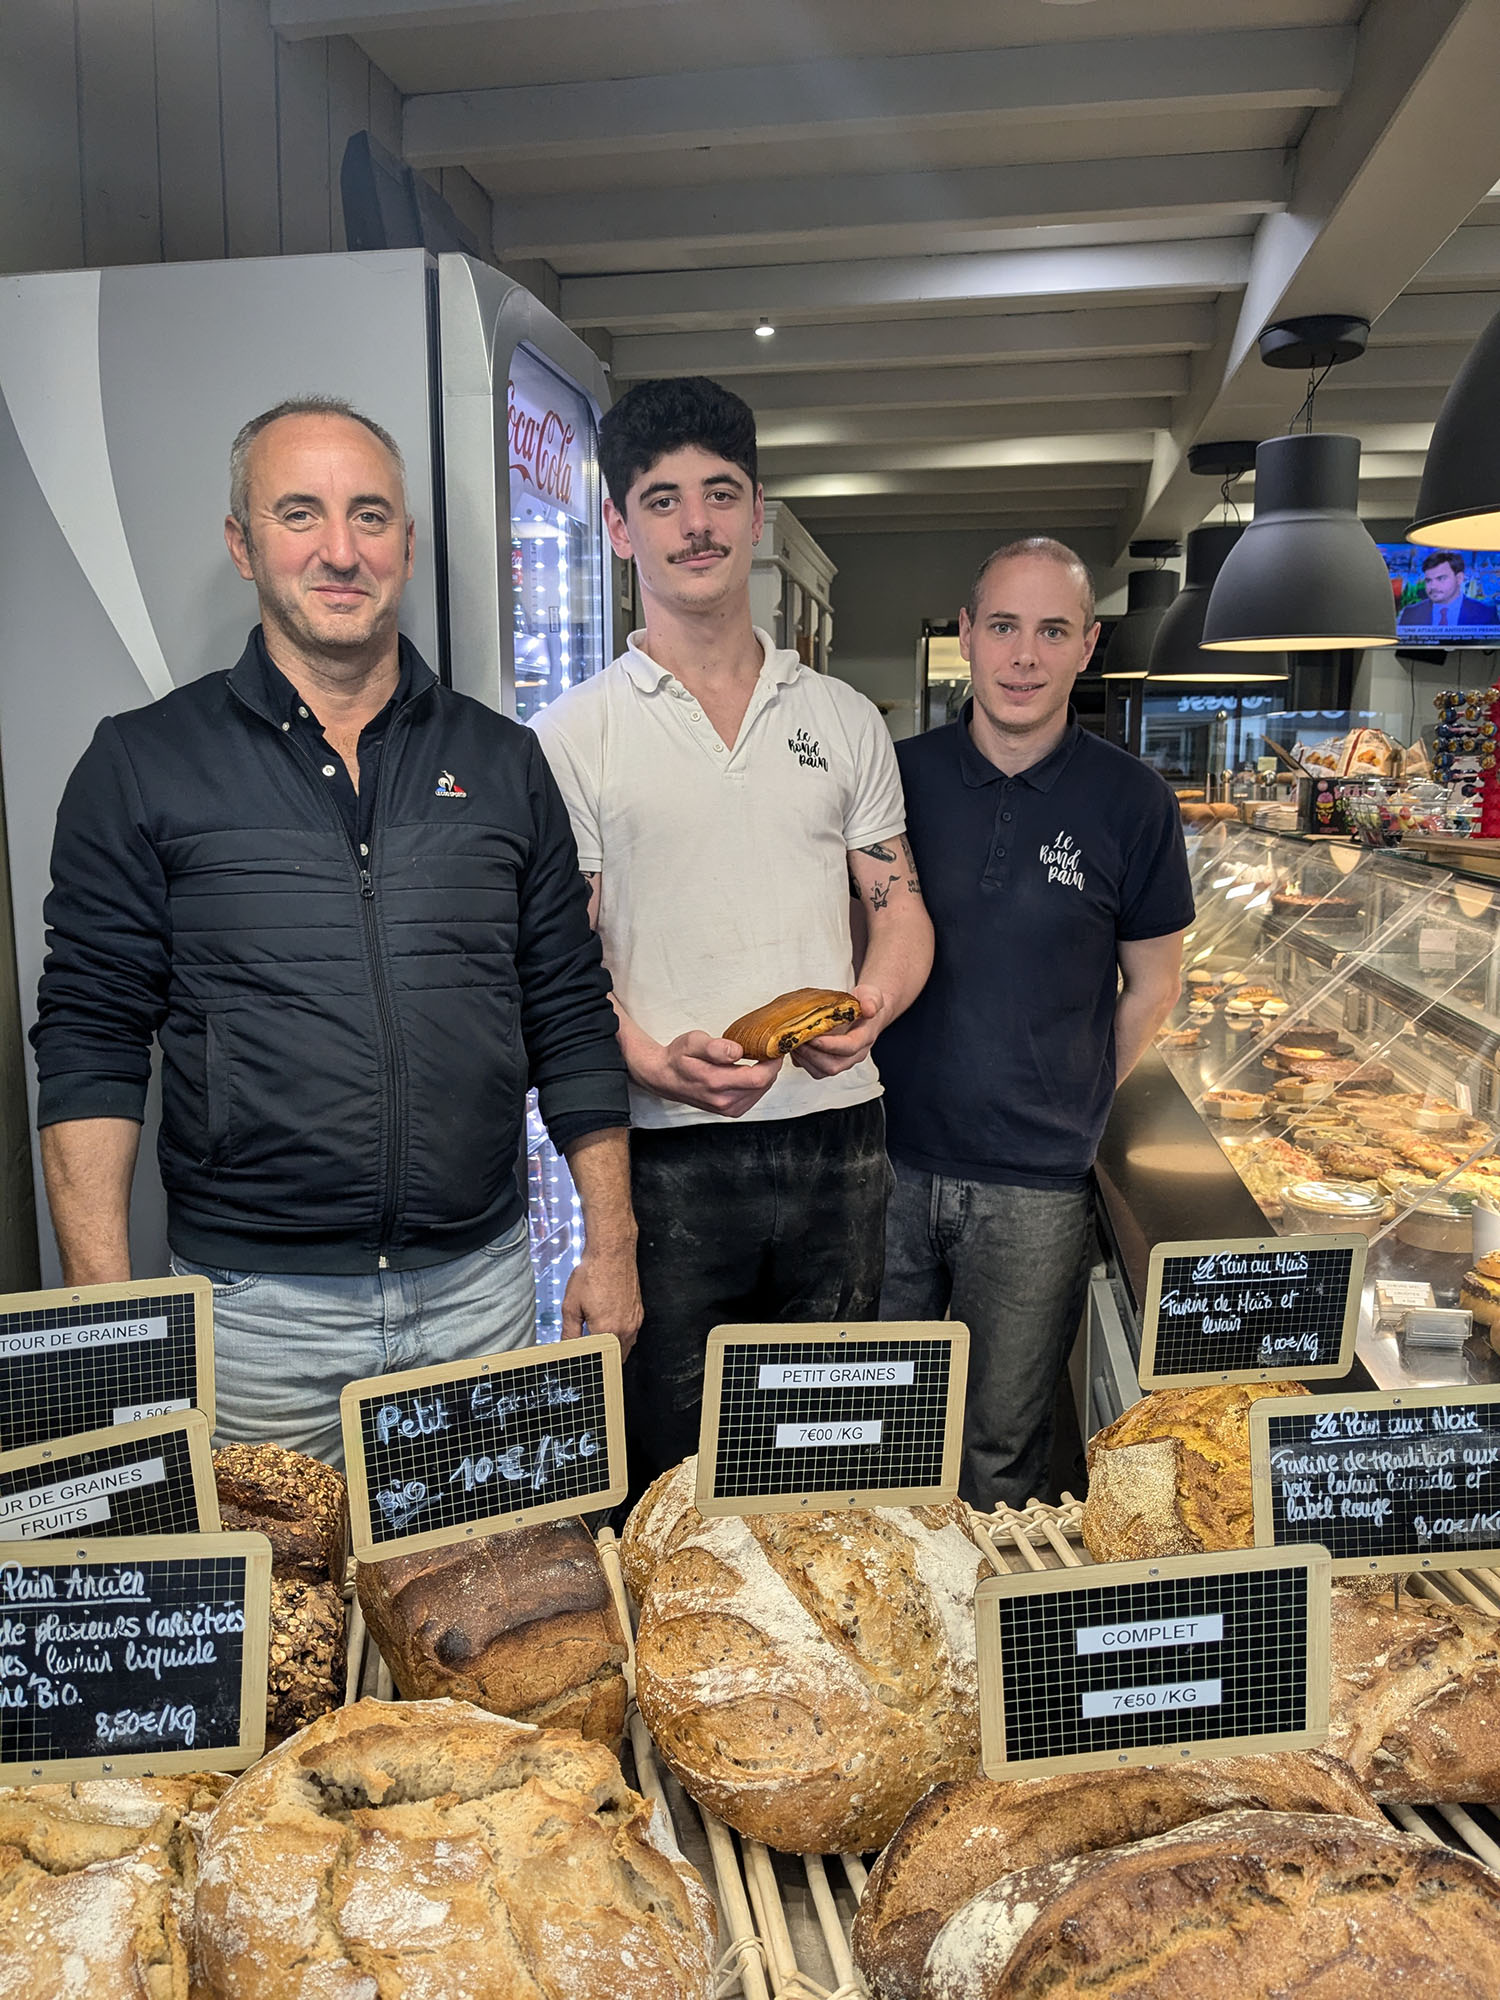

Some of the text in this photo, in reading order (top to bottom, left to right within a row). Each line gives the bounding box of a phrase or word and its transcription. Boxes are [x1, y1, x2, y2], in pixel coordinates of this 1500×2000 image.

[508, 380, 576, 504] oca-Cola
[797, 728, 811, 742] Le
[788, 738, 820, 757] Rond
[1053, 831, 1074, 851] Le
[1040, 844, 1081, 870] Rond
[1192, 1253, 1217, 1280] Le
[1218, 1250, 1248, 1276] Pain
[1251, 1260, 1271, 1274] au
[1214, 1293, 1231, 1312] de
[1280, 1289, 1300, 1309] et
[50, 1332, 73, 1347] DE
[77, 1323, 149, 1343] GRAINES
[1202, 1314, 1242, 1334] levain
[782, 1367, 896, 1383] PETIT GRAINES
[377, 1398, 450, 1446] Petit
[1311, 1405, 1479, 1440] Le Pain aux Noix
[799, 1427, 863, 1442] 7€00 /KG
[1343, 1450, 1369, 1472] de
[1462, 1447, 1500, 1465] aux
[29, 1490, 56, 1509] DE
[60, 1468, 143, 1500] GRAINES
[1465, 1465, 1491, 1489] et
[1287, 1496, 1336, 1523] label
[21, 1508, 88, 1536] FRUITS
[64, 1568, 145, 1600] Ancien
[1102, 1623, 1199, 1646] COMPLET
[125, 1637, 217, 1680] liquide
[1113, 1688, 1197, 1709] 7€50 /KG
